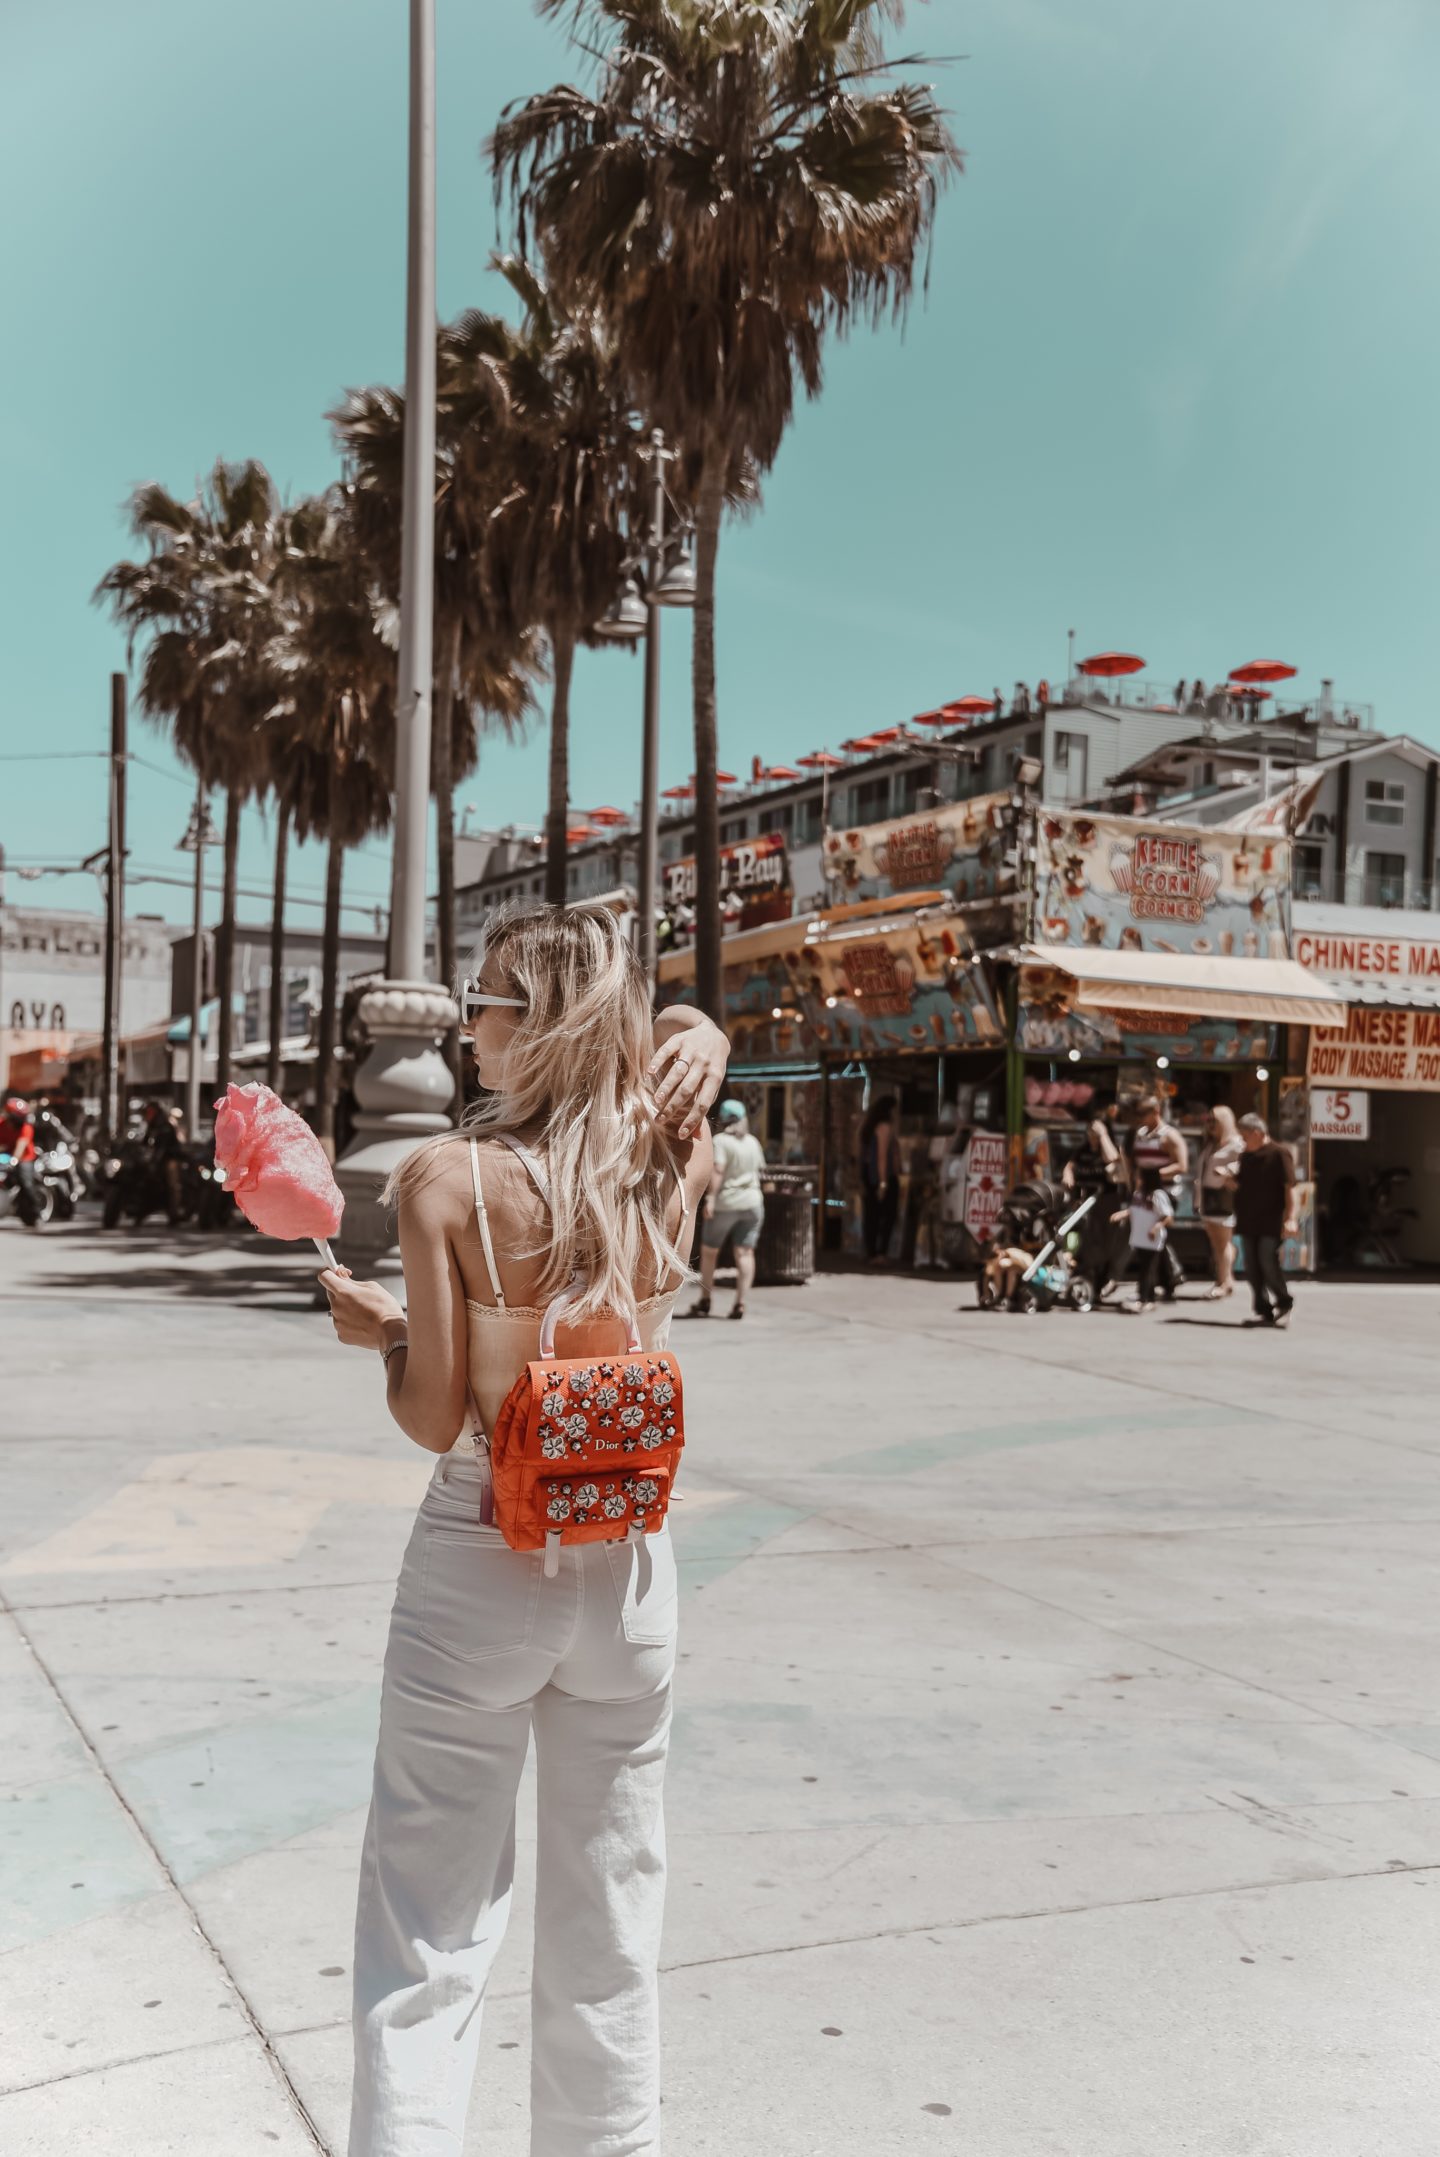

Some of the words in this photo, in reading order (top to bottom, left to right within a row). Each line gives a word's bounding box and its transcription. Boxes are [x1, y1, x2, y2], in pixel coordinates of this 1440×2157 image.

[732, 846, 783, 886] Bay
[1135, 836, 1197, 873] KETTLE
[1141, 871, 1191, 896] CORN
[1135, 899, 1198, 919] CORNER
[1298, 938, 1400, 973] CHINESE
[11, 1000, 64, 1029] AYA
[1310, 1047, 1346, 1077] BODY
[1348, 1050, 1406, 1080] MASSAGE
[1326, 1090, 1351, 1121] $5
[1310, 1122, 1362, 1135] MASSAGE
[972, 1140, 1005, 1161] ATM
[968, 1190, 1003, 1212] ATM
[594, 1439, 620, 1450] Dior
